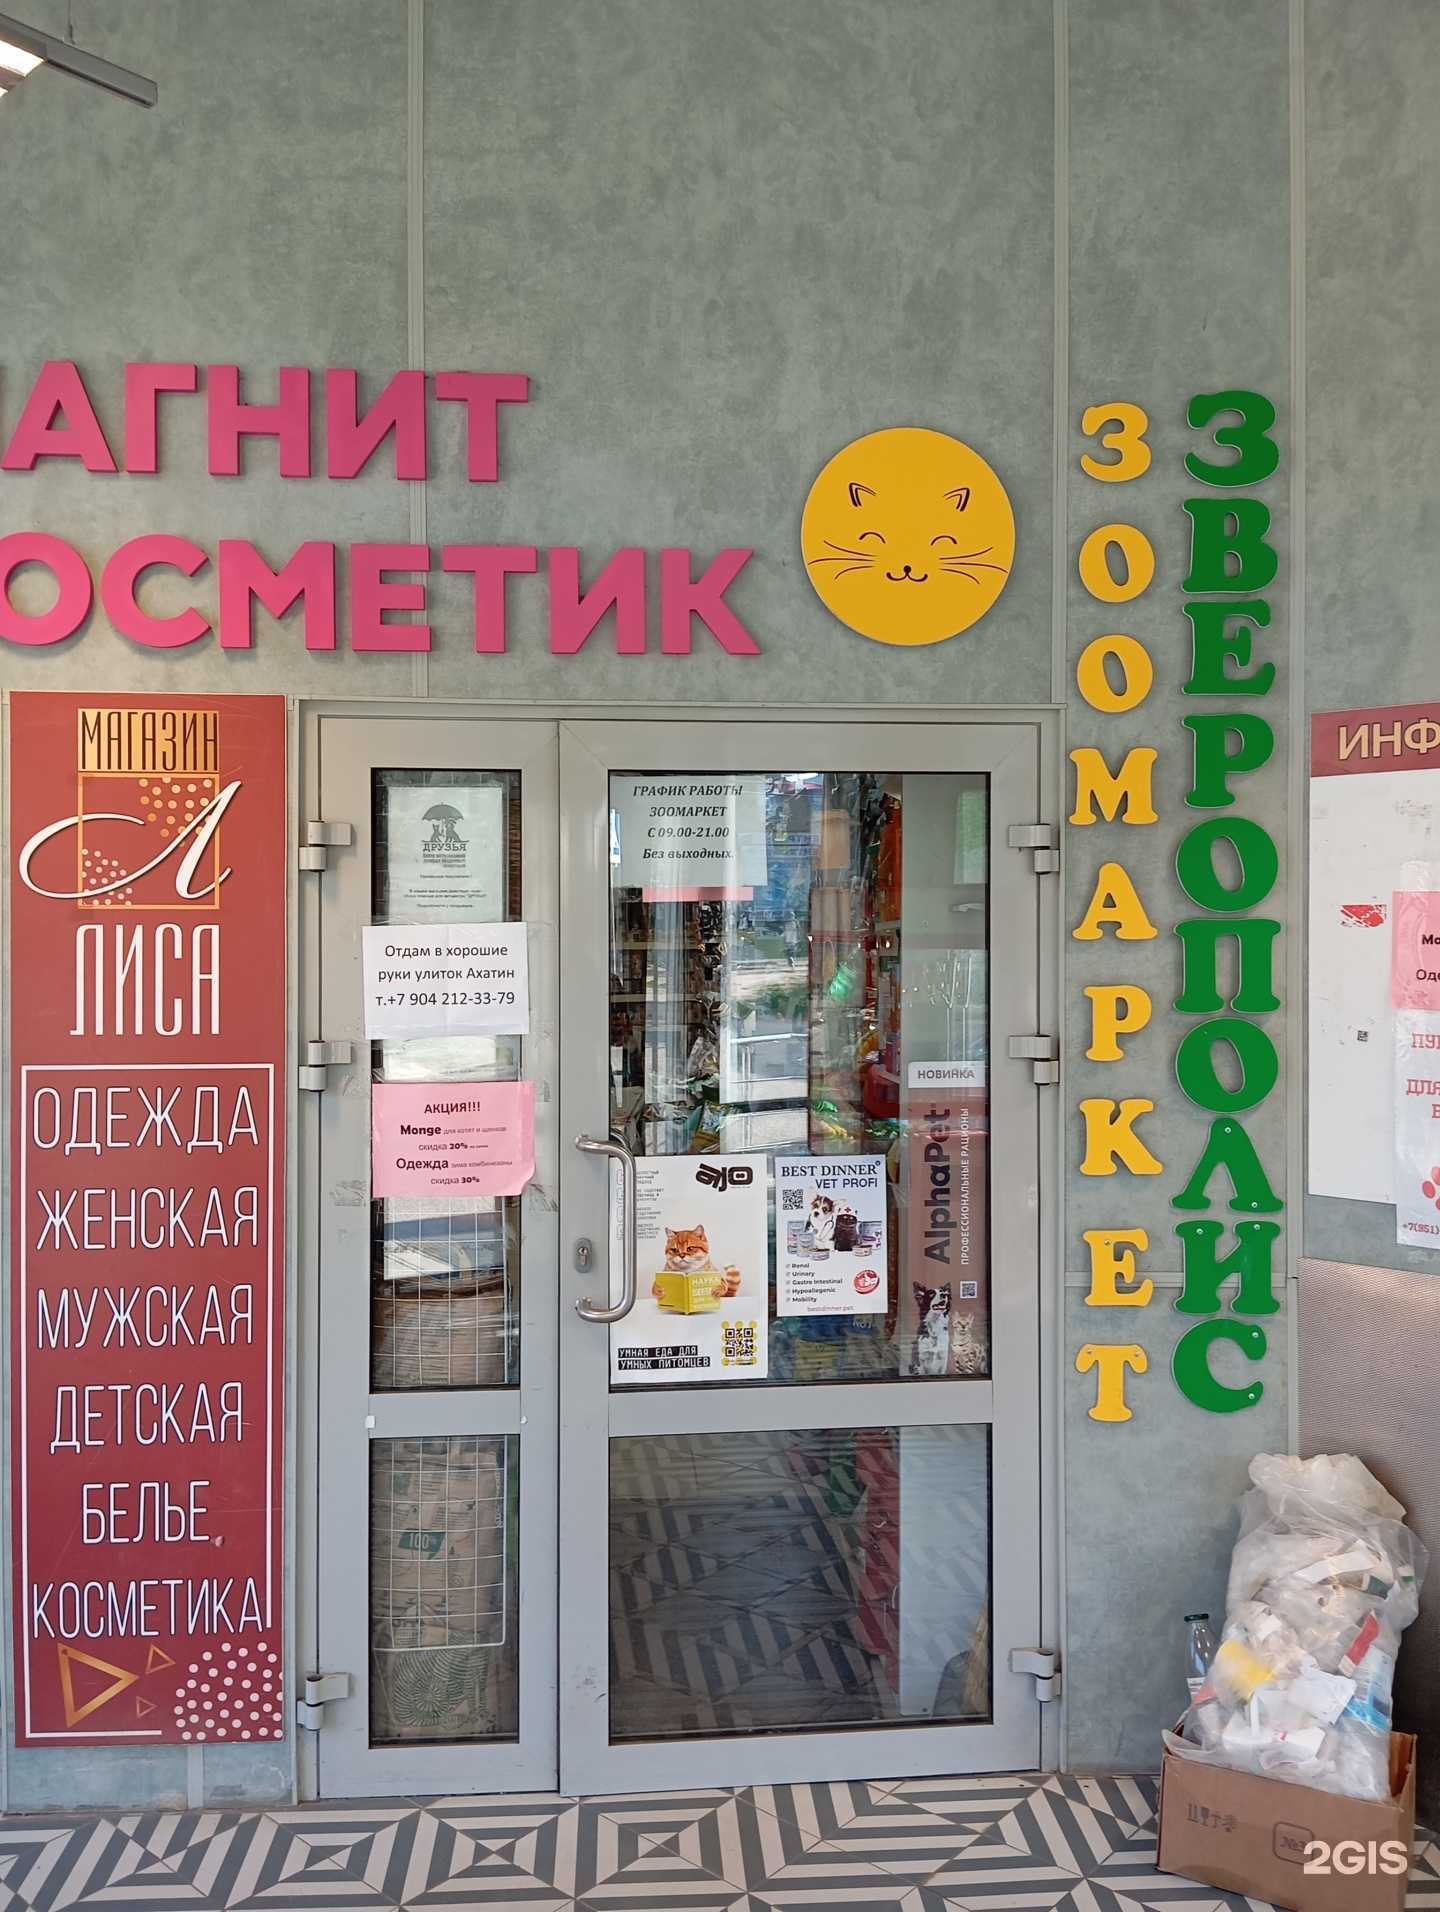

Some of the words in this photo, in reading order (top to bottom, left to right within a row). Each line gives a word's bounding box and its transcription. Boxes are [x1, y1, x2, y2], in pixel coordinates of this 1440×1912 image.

[0, 532, 761, 655] ОСМЕТИК
[82, 710, 218, 771] МАГАЗИН
[633, 785, 687, 796] ГРАФИК
[689, 785, 743, 796] РАБОТЫ
[649, 806, 727, 817] ЗООМАРКЕТ
[658, 827, 729, 838] 09.00-21.00
[423, 843, 466, 852] ДРУЗЬЯ
[643, 849, 664, 859] Без
[1171, 390, 1283, 1413] ЗВЕРОПОЛИС
[1069, 402, 1163, 1422] ЗООМАРКЕТ
[385, 945, 431, 957] Отдам
[435, 948, 442, 956] в
[446, 946, 508, 958] хорошие
[378, 970, 411, 982] руки
[415, 970, 462, 981] улиток
[466, 967, 515, 979] Ахатин
[376, 994, 405, 1006] т.+7
[410, 993, 436, 1005] 904
[442, 992, 515, 1005] 212-33-79
[918, 1068, 975, 1080] НОВИНКА
[424, 1101, 481, 1114] АКЦИЯ!!!
[33, 1086, 259, 1156] ОДЕЖДА
[400, 1125, 441, 1136] Monge
[960, 1108, 969, 1157] РАЦИОНЫ
[418, 1143, 448, 1151] скидка
[449, 1142, 468, 1150] 20%
[396, 1158, 449, 1170] Одежда
[781, 1166, 817, 1177] BEST
[430, 1177, 460, 1185] скидка
[461, 1176, 480, 1184] 30%
[815, 1179, 838, 1189] VET
[843, 1178, 878, 1188] PROFI
[924, 1108, 957, 1265] AlphaPet
[36, 1186, 258, 1250] ЖЕНСКАЯ
[960, 1159, 969, 1265] ПРОФЕССИОНАЛЬНЫЕ
[38, 1284, 253, 1349] МУЖСКАЯ
[619, 1348, 649, 1358] УМНАЯ
[655, 1347, 673, 1356] ЕДА
[678, 1346, 698, 1356] ДЛЯ
[620, 1359, 651, 1369] УМНЫХ
[658, 1357, 709, 1368] ПИТОМЦЕВ
[50, 1382, 243, 1454] ДЕТСКАЯ
[33, 1577, 263, 1639] КОСМЕТИКА
